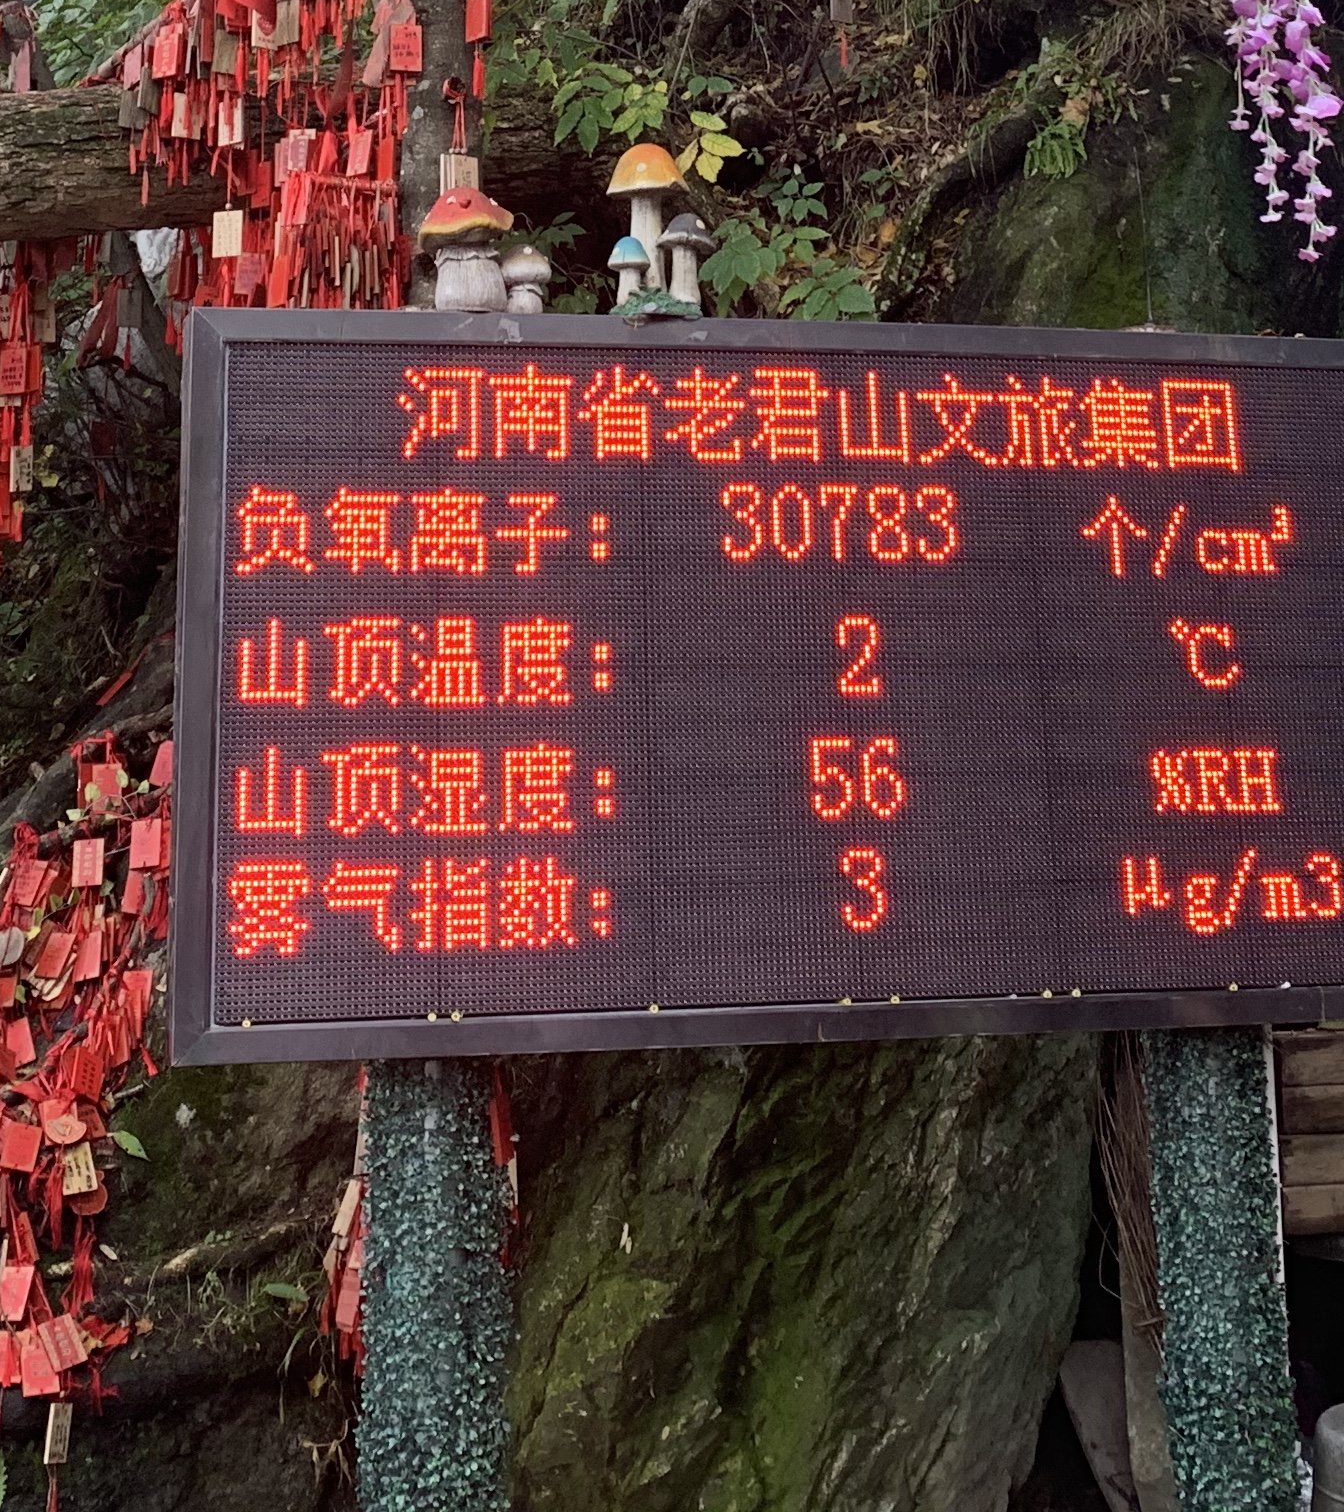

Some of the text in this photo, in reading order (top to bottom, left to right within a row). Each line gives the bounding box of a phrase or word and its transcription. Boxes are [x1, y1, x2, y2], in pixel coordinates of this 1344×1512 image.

[397, 362, 1241, 473] 河南省老君山文旅集团
[721, 483, 957, 563] 30783
[836, 614, 882, 697] 2
[808, 736, 906, 821] 56
[1151, 747, 1285, 814] %RH
[840, 846, 888, 933] 3
